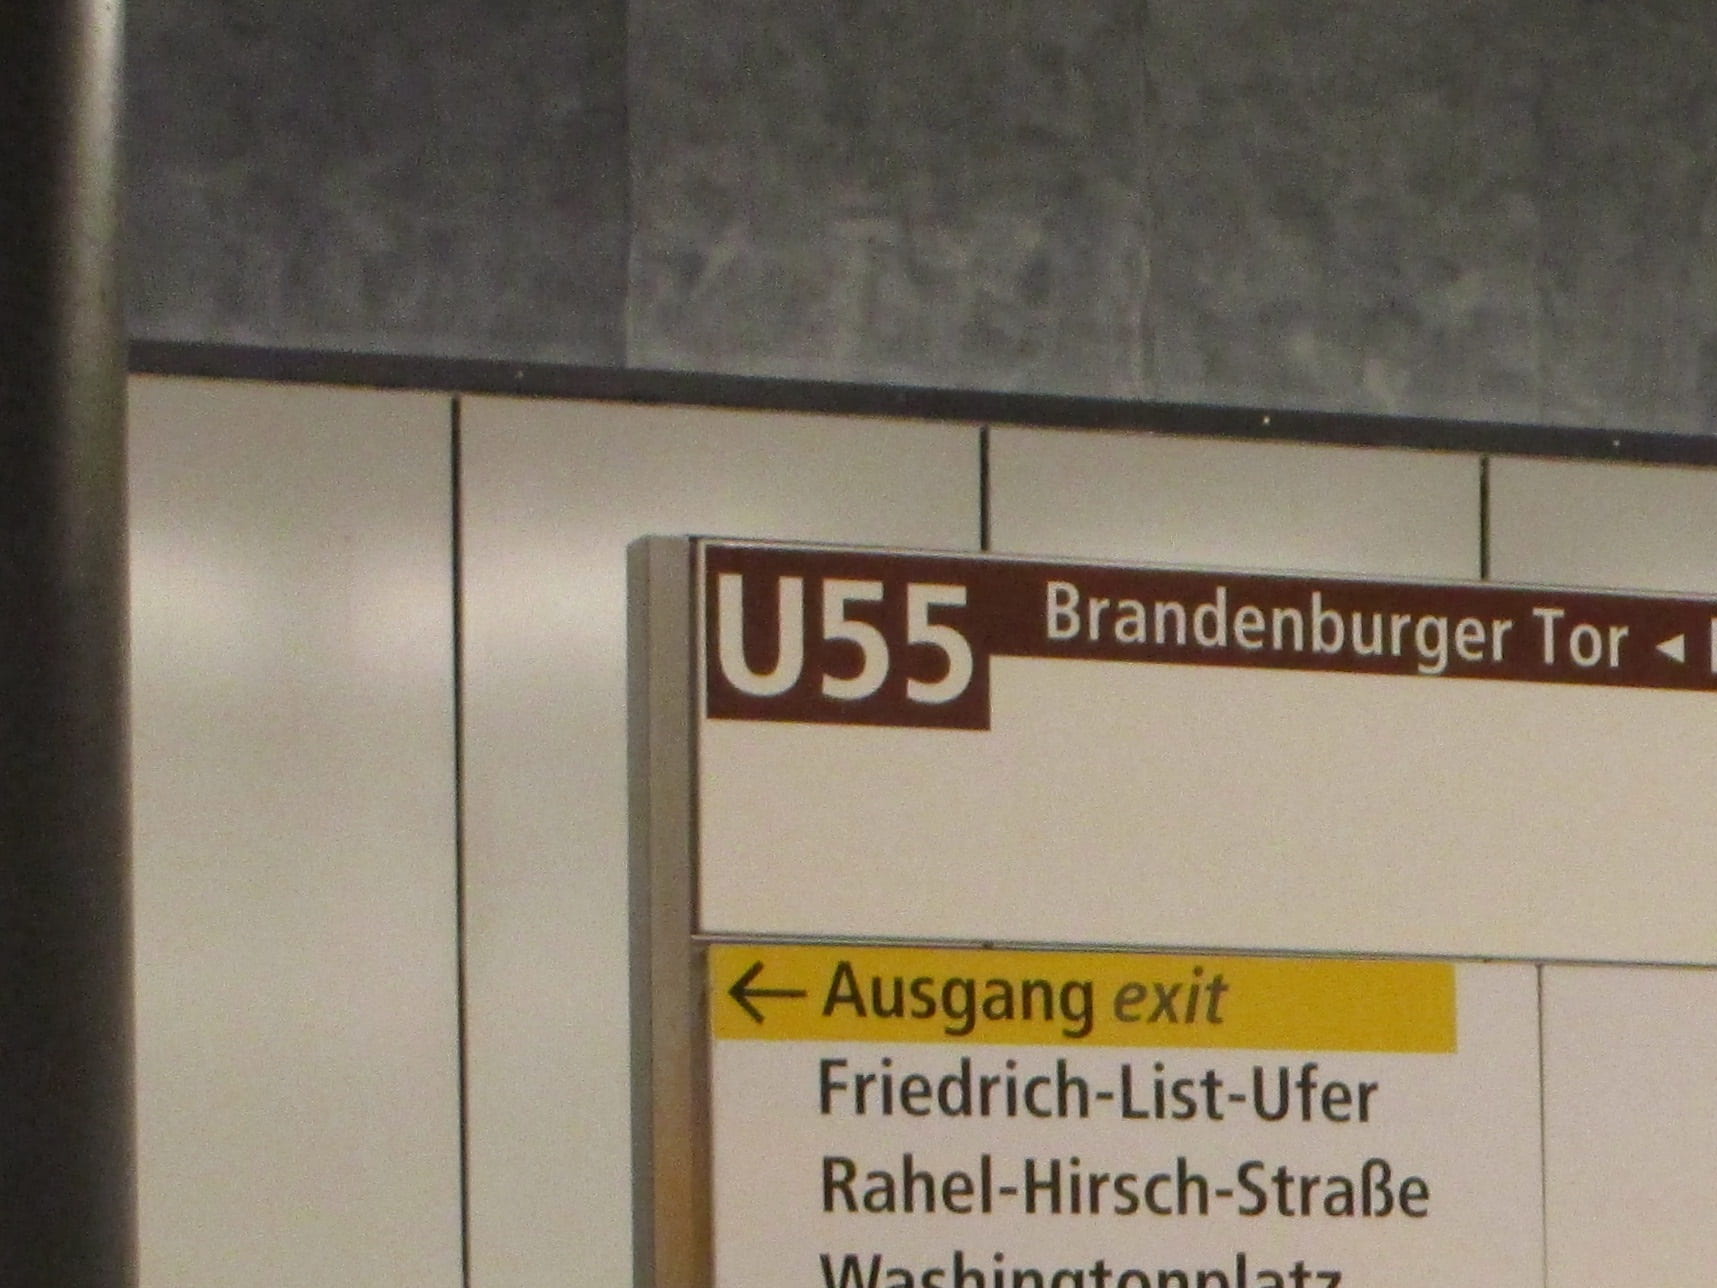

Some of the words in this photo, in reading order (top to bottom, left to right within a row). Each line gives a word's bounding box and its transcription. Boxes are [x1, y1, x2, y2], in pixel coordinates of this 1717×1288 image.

[716, 572, 974, 704] U55
[1045, 580, 1512, 676] Brandenburger
[1535, 607, 1630, 667] Tor
[821, 959, 1095, 1038] Ausgang
[1112, 968, 1230, 1026] exit
[817, 1057, 1379, 1124] Friedrich-List-Ufer
[820, 1153, 1431, 1221] Rahel-Hirsch-Straße
